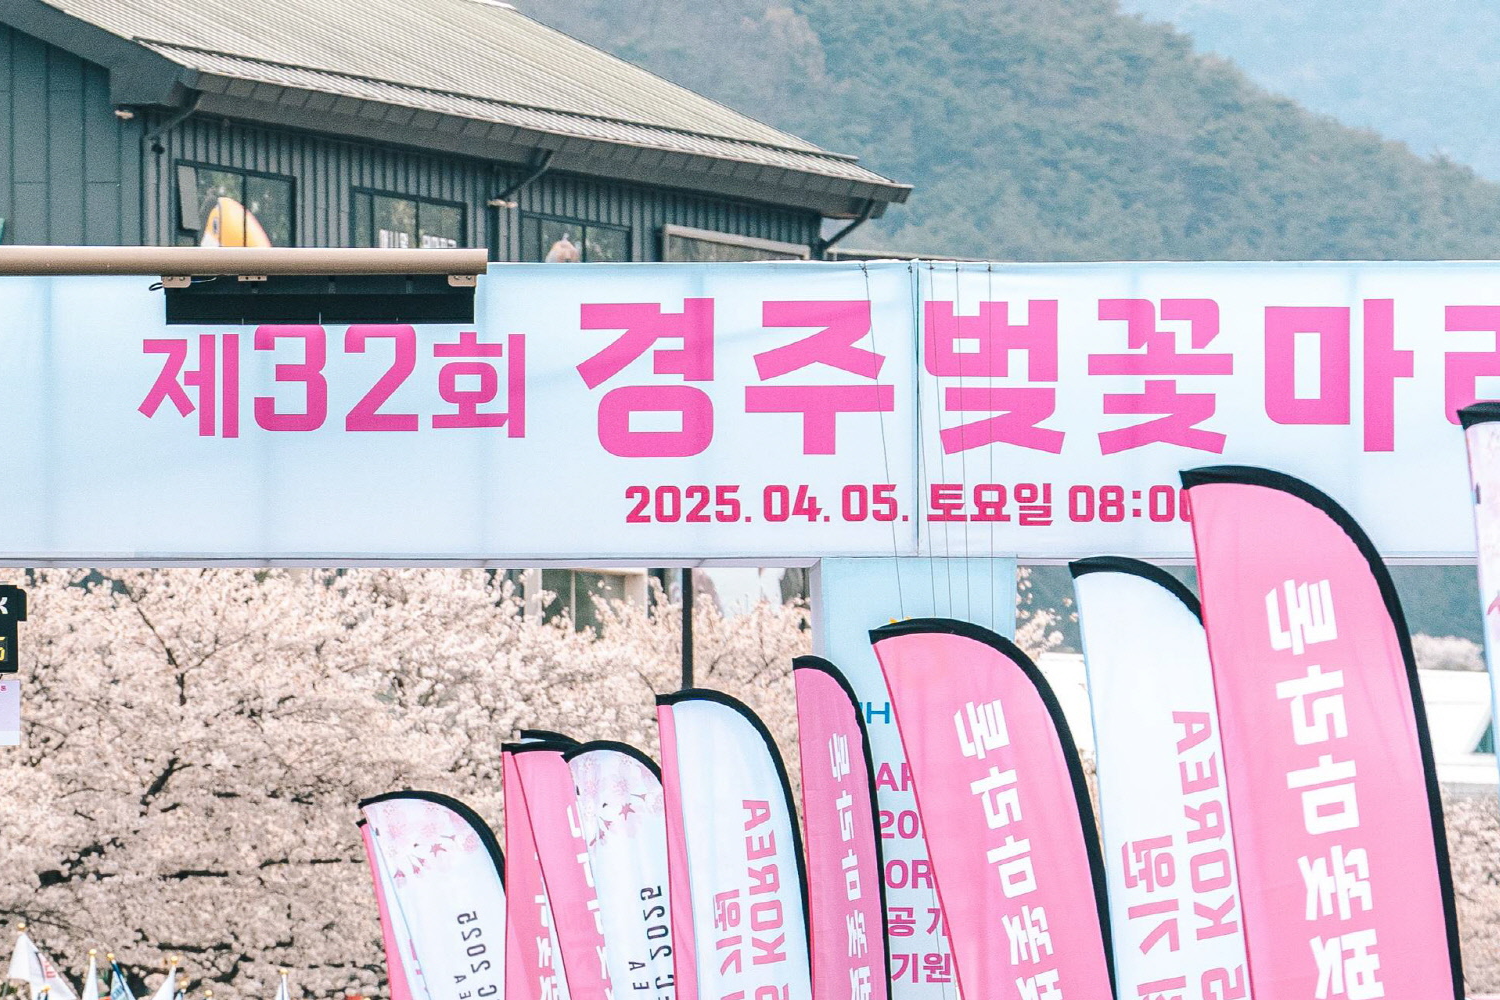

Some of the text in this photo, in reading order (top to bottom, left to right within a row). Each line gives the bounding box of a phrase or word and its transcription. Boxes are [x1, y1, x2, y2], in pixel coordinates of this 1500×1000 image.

[137, 324, 525, 438] 제32회
[927, 484, 1052, 526] 토요일
[891, 953, 952, 983] 기원
